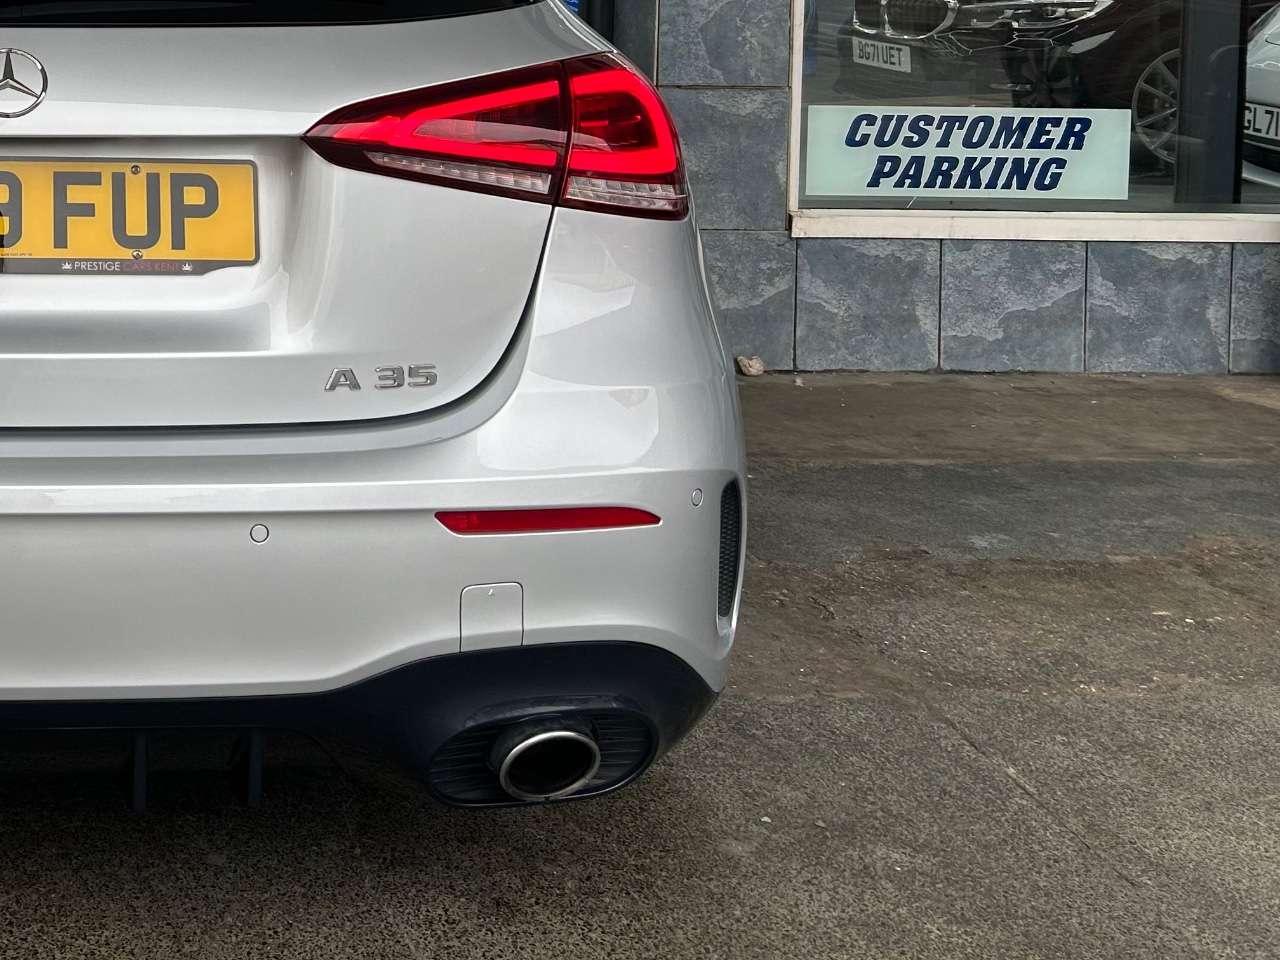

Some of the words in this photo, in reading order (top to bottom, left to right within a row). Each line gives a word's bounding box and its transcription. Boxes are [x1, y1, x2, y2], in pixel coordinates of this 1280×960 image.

[881, 45, 903, 67] UET
[845, 113, 1093, 151] CUSTOMER
[866, 155, 1068, 192] PARKING
[52, 171, 220, 250] FUP
[74, 261, 120, 272] PRESTIGE
[324, 367, 361, 391] A
[374, 364, 438, 390] 35
